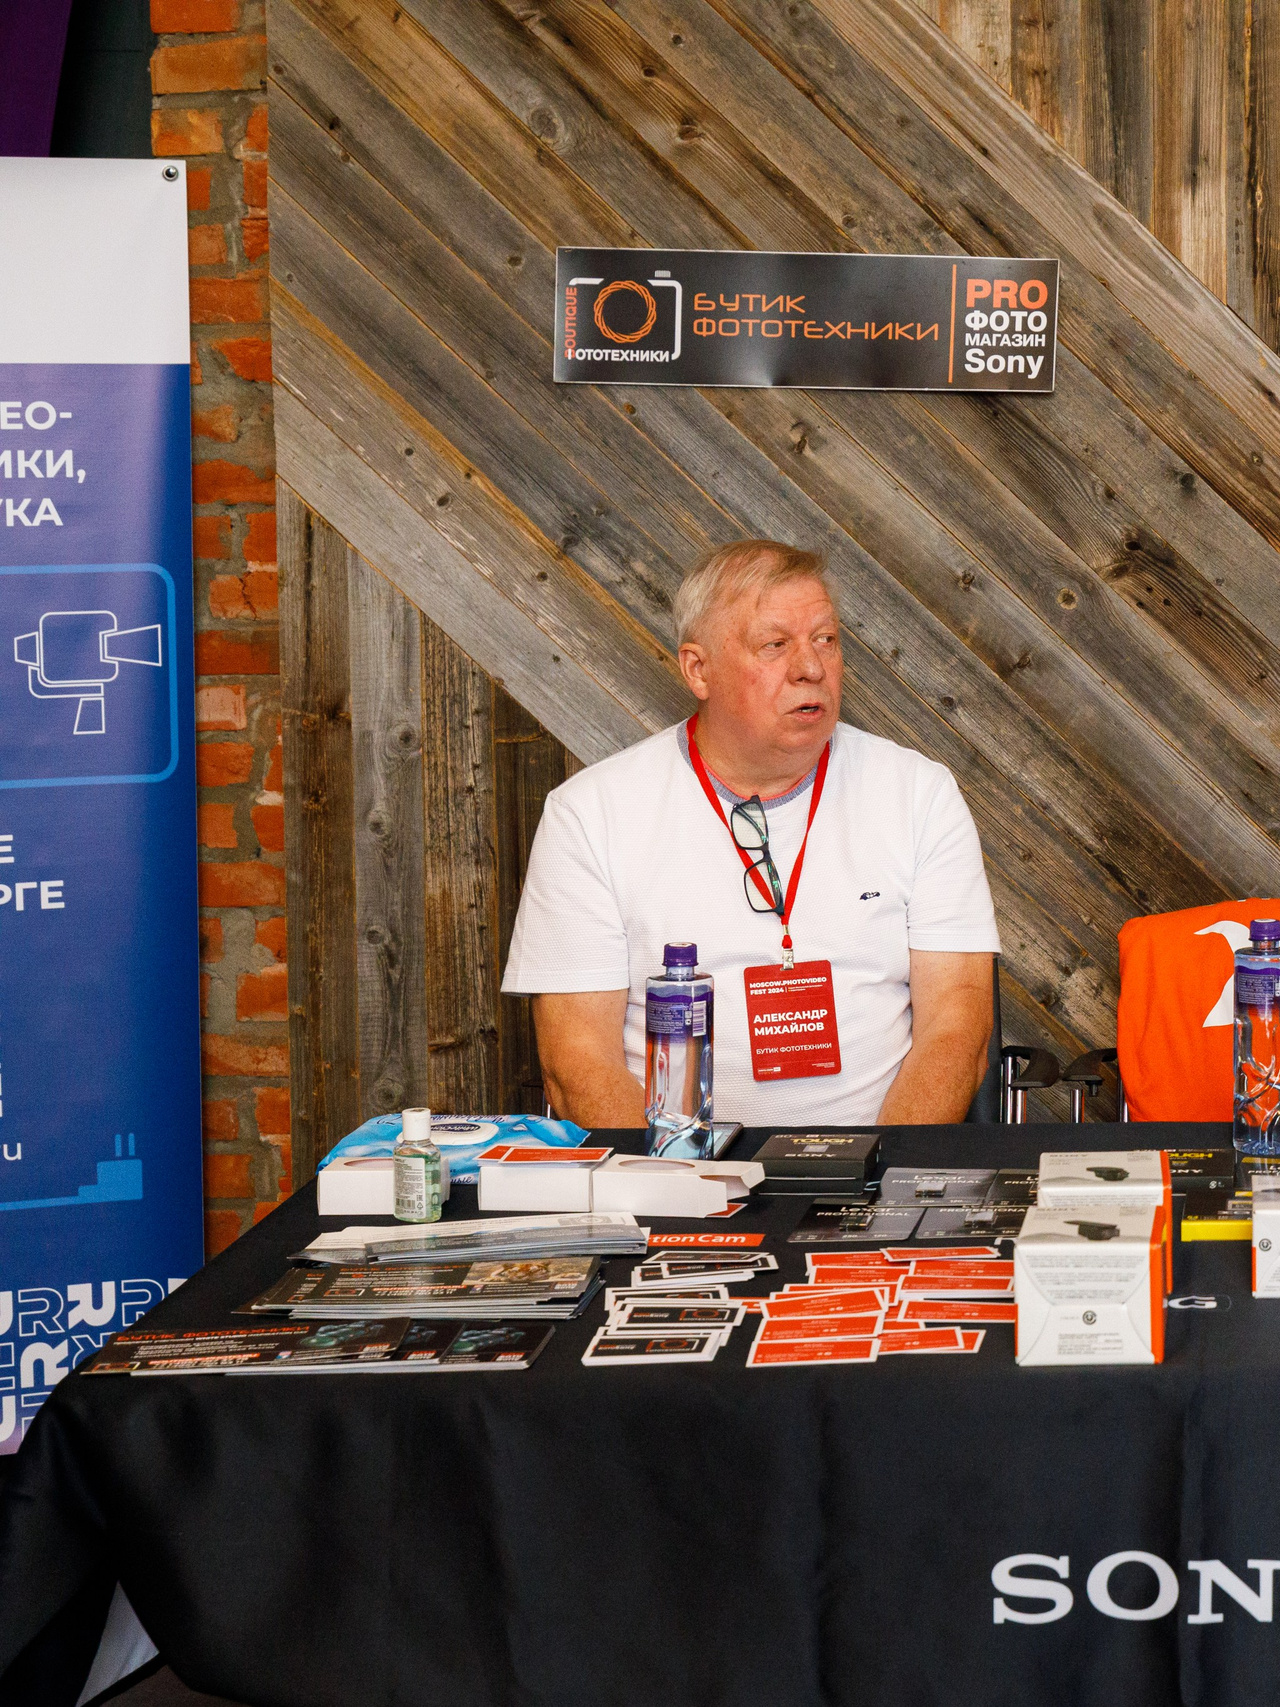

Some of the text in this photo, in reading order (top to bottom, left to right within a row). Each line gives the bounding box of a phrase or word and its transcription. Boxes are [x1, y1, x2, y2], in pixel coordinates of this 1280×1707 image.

[694, 293, 806, 313] БУТИК
[965, 279, 1049, 310] PRO
[693, 317, 940, 341] ФОТОТЕХНИКИ
[964, 310, 1048, 332] ФОТО
[964, 333, 1046, 347] МАГАЗИН
[964, 348, 1045, 379] Sony
[749, 976, 827, 989] MOSCOW.PHOTOVIDEO
[753, 1008, 828, 1024] АЛЕКСАНДР
[754, 1021, 825, 1037] МИХАЙЛОВ
[756, 1042, 832, 1055] БУТИК ФОТОТЕХНИКИ
